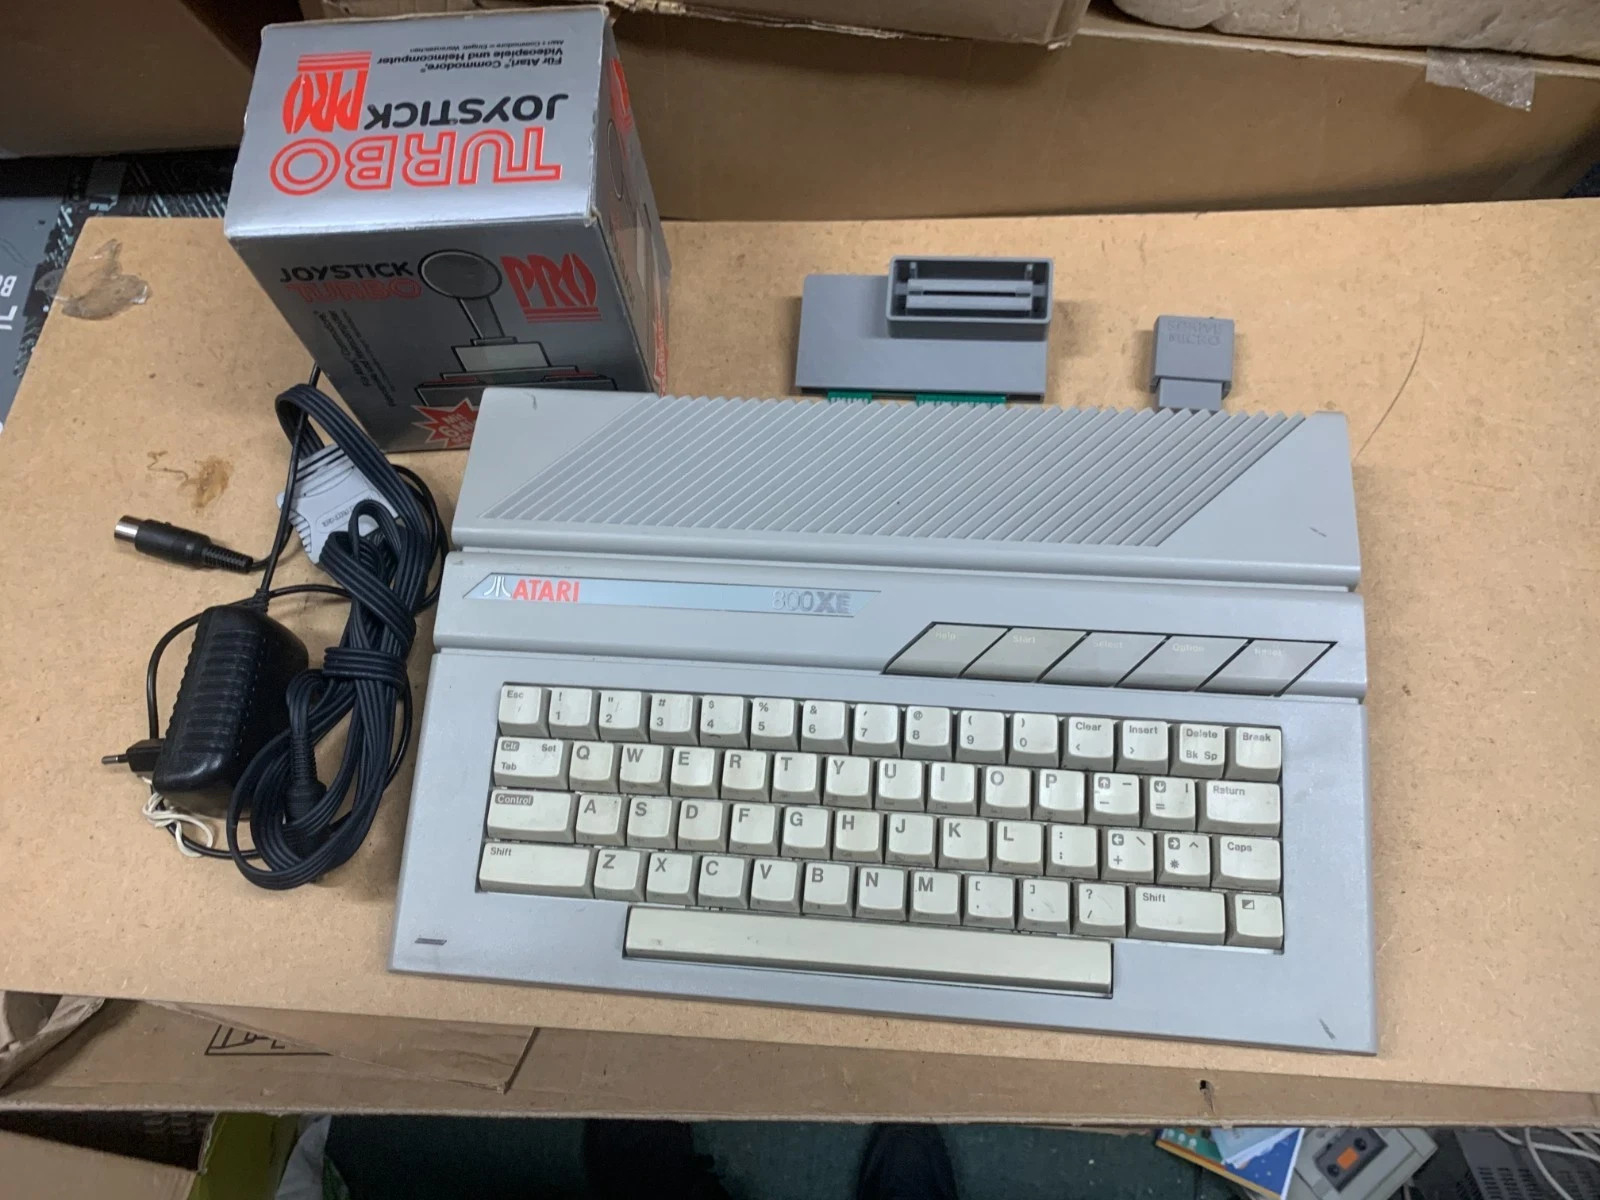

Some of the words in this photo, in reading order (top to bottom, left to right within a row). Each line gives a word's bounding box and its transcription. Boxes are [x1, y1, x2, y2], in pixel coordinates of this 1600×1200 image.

[377, 53, 466, 65] Heimcomputer
[468, 51, 491, 59] und
[493, 48, 563, 59] Videospiele
[544, 57, 562, 65] Für
[283, 71, 367, 134] PRO
[364, 94, 569, 130] JOYSTICK
[270, 127, 562, 196] TURBO
[280, 261, 415, 283] JOYSTICK
[501, 253, 598, 308] PRO
[286, 278, 423, 303] TURBO
[512, 579, 580, 602] ATARI
[772, 590, 853, 614] 800XE
[1013, 635, 1036, 644] Start
[507, 690, 523, 699] Esc
[659, 699, 667, 707] #
[759, 702, 769, 713] %
[810, 705, 818, 715] &
[913, 711, 924, 721] @
[606, 714, 613, 724] 2
[657, 717, 664, 727] 3
[707, 719, 715, 729] 4
[758, 722, 766, 732] 5
[809, 724, 817, 735] 6
[861, 728, 869, 738] 7
[1076, 722, 1102, 732] Clear
[1130, 725, 1158, 735] Insert
[1186, 728, 1218, 739] Delete
[913, 730, 921, 741] 8
[967, 735, 975, 745] 9
[1243, 733, 1272, 742] Break
[503, 741, 519, 751] Clr
[542, 744, 557, 753] Set
[1020, 738, 1028, 748] 0
[576, 745, 591, 761] Q
[627, 748, 644, 763] W
[678, 751, 691, 766] E
[1186, 750, 1199, 760] Bk
[1205, 751, 1218, 762] Sp
[502, 762, 517, 771] Tab
[730, 754, 742, 769] R
[781, 757, 793, 772] T
[834, 760, 845, 775] Y
[885, 763, 897, 779] U
[991, 771, 1005, 786] O
[1046, 774, 1058, 789] P
[1213, 785, 1246, 796] Return
[496, 794, 532, 806] Control
[584, 799, 597, 815] A
[635, 802, 648, 817] S
[686, 805, 699, 820] D
[739, 808, 751, 823] F
[790, 811, 804, 827] G
[842, 815, 855, 831] H
[896, 819, 906, 834] J
[949, 823, 962, 838] K
[1004, 826, 1015, 842] L
[491, 847, 512, 857] Shift
[1227, 842, 1253, 853] Caps
[603, 854, 617, 870] Z
[655, 858, 668, 873] X
[1113, 856, 1123, 866] +
[706, 860, 719, 877] C
[760, 864, 773, 880] V
[812, 867, 824, 884] B
[866, 872, 879, 888] N
[919, 877, 934, 893] M
[1086, 889, 1093, 900] ?
[1143, 893, 1166, 903] Shift
